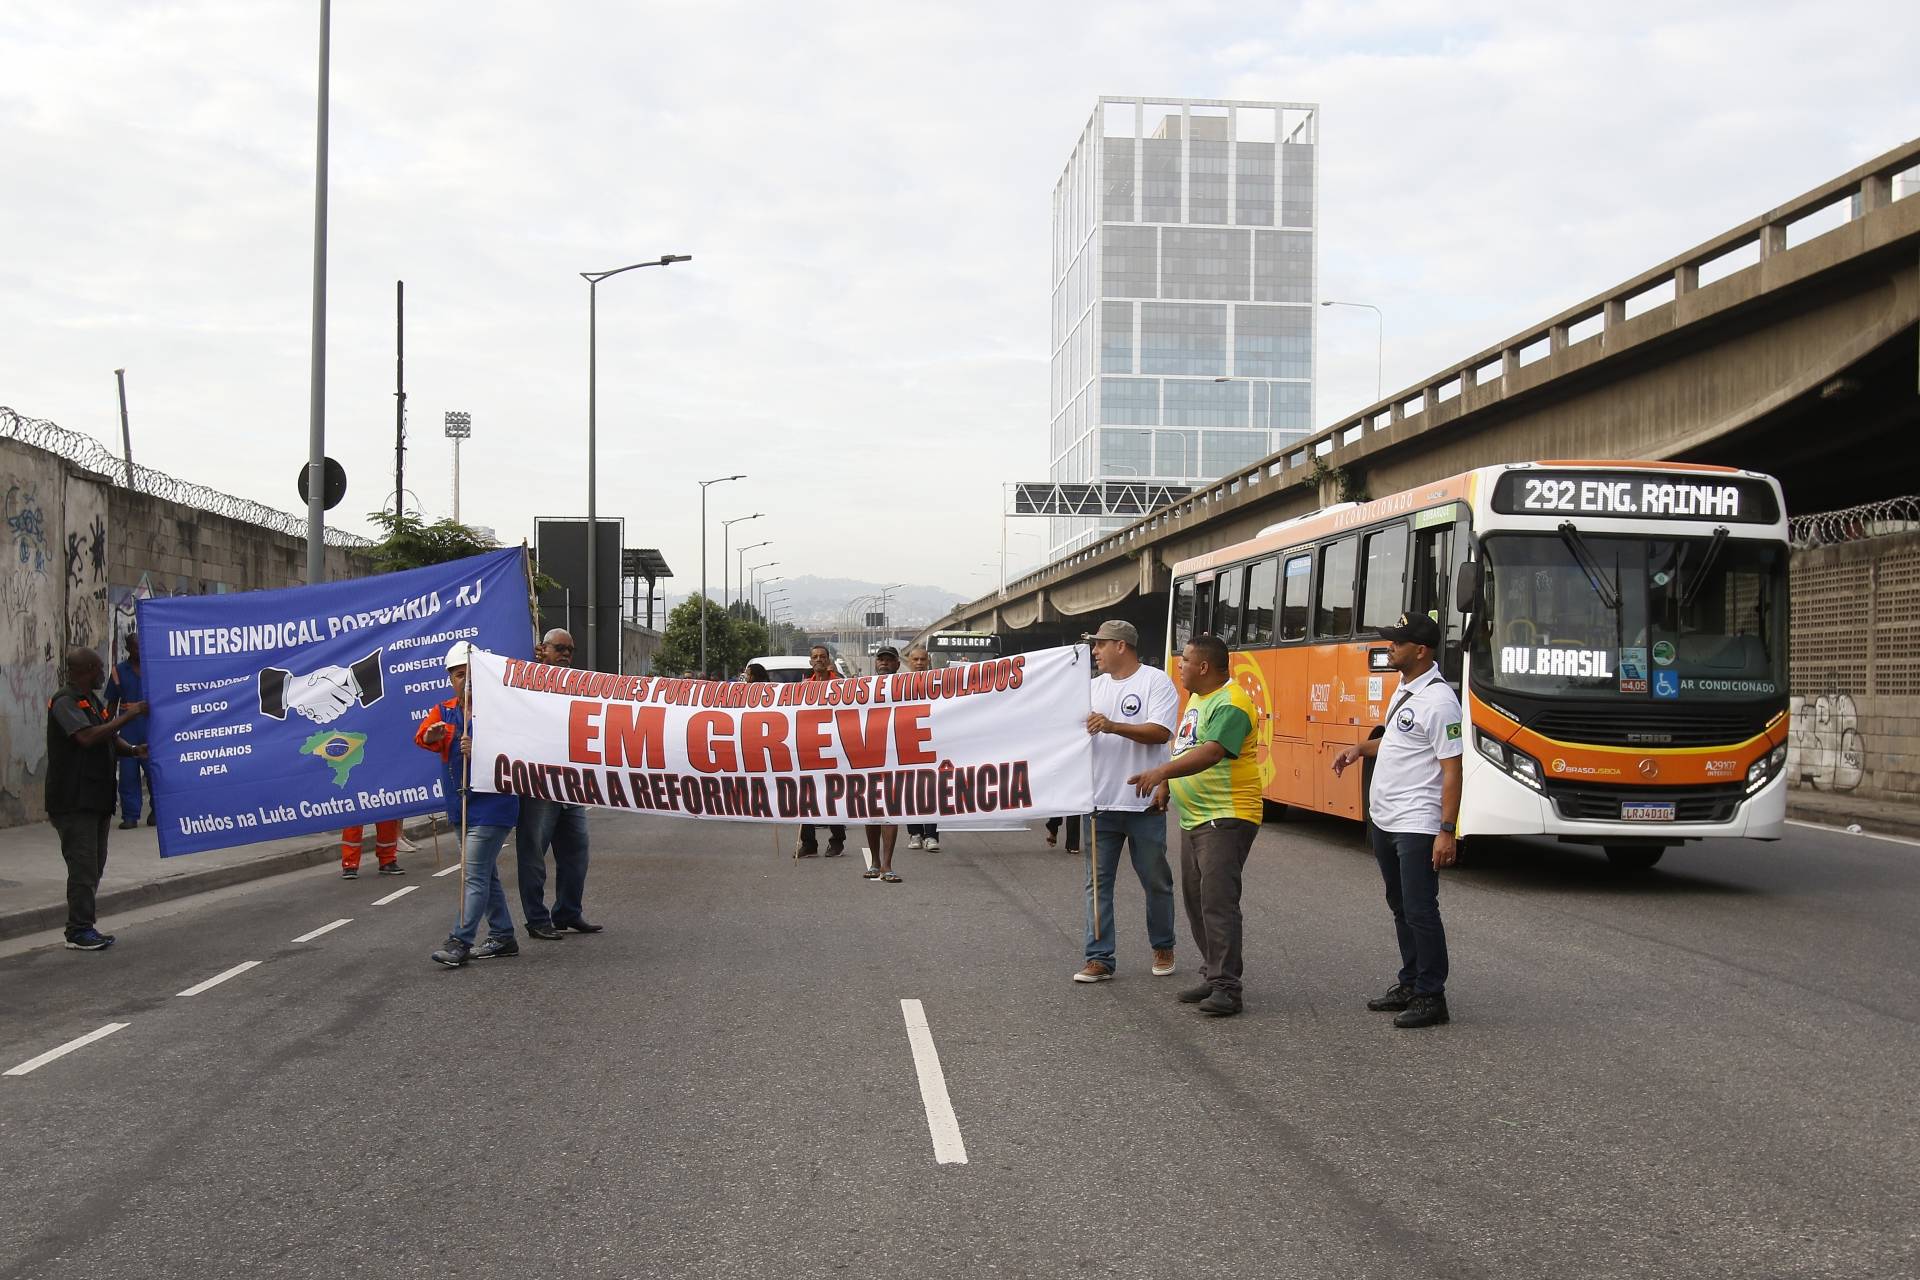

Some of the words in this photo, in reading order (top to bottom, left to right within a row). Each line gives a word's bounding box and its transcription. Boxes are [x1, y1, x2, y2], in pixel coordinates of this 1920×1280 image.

[1524, 479, 1576, 510] 292
[1581, 481, 1637, 513] ENG.
[1641, 484, 1739, 516] RAINHA
[168, 618, 325, 657] INTERSINDICAL
[388, 627, 479, 652] ARRUMADORES
[951, 637, 992, 647] SULACAP
[389, 655, 447, 674] CONSERT
[404, 675, 453, 695] PORTUÁ
[502, 657, 655, 702] TRABALHADORES
[777, 676, 871, 707] AVULSOS
[874, 674, 887, 703] E
[890, 655, 1026, 701] VINCULADOS
[1680, 679, 1695, 690] AR
[1699, 680, 1776, 694] CONDICIONADO
[191, 701, 228, 715] BLOCO
[174, 723, 253, 743] CONFERENTES
[568, 699, 666, 770] EM
[686, 703, 937, 774] GREVE
[179, 744, 253, 763] AEROVIÁRIOS
[199, 764, 229, 777] APEA
[1704, 760, 1737, 771] A29107
[494, 753, 606, 806] CONTRA
[604, 770, 634, 808] A
[628, 773, 774, 818] REFORMA
[775, 774, 821, 818] DA
[824, 759, 1033, 819] PREVIDÊNCIA
[179, 815, 234, 836] Unidos
[236, 813, 257, 829] na
[258, 804, 298, 825] Luta
[299, 797, 356, 819] Contra
[357, 785, 430, 811] Reforma
[431, 778, 445, 799] d
